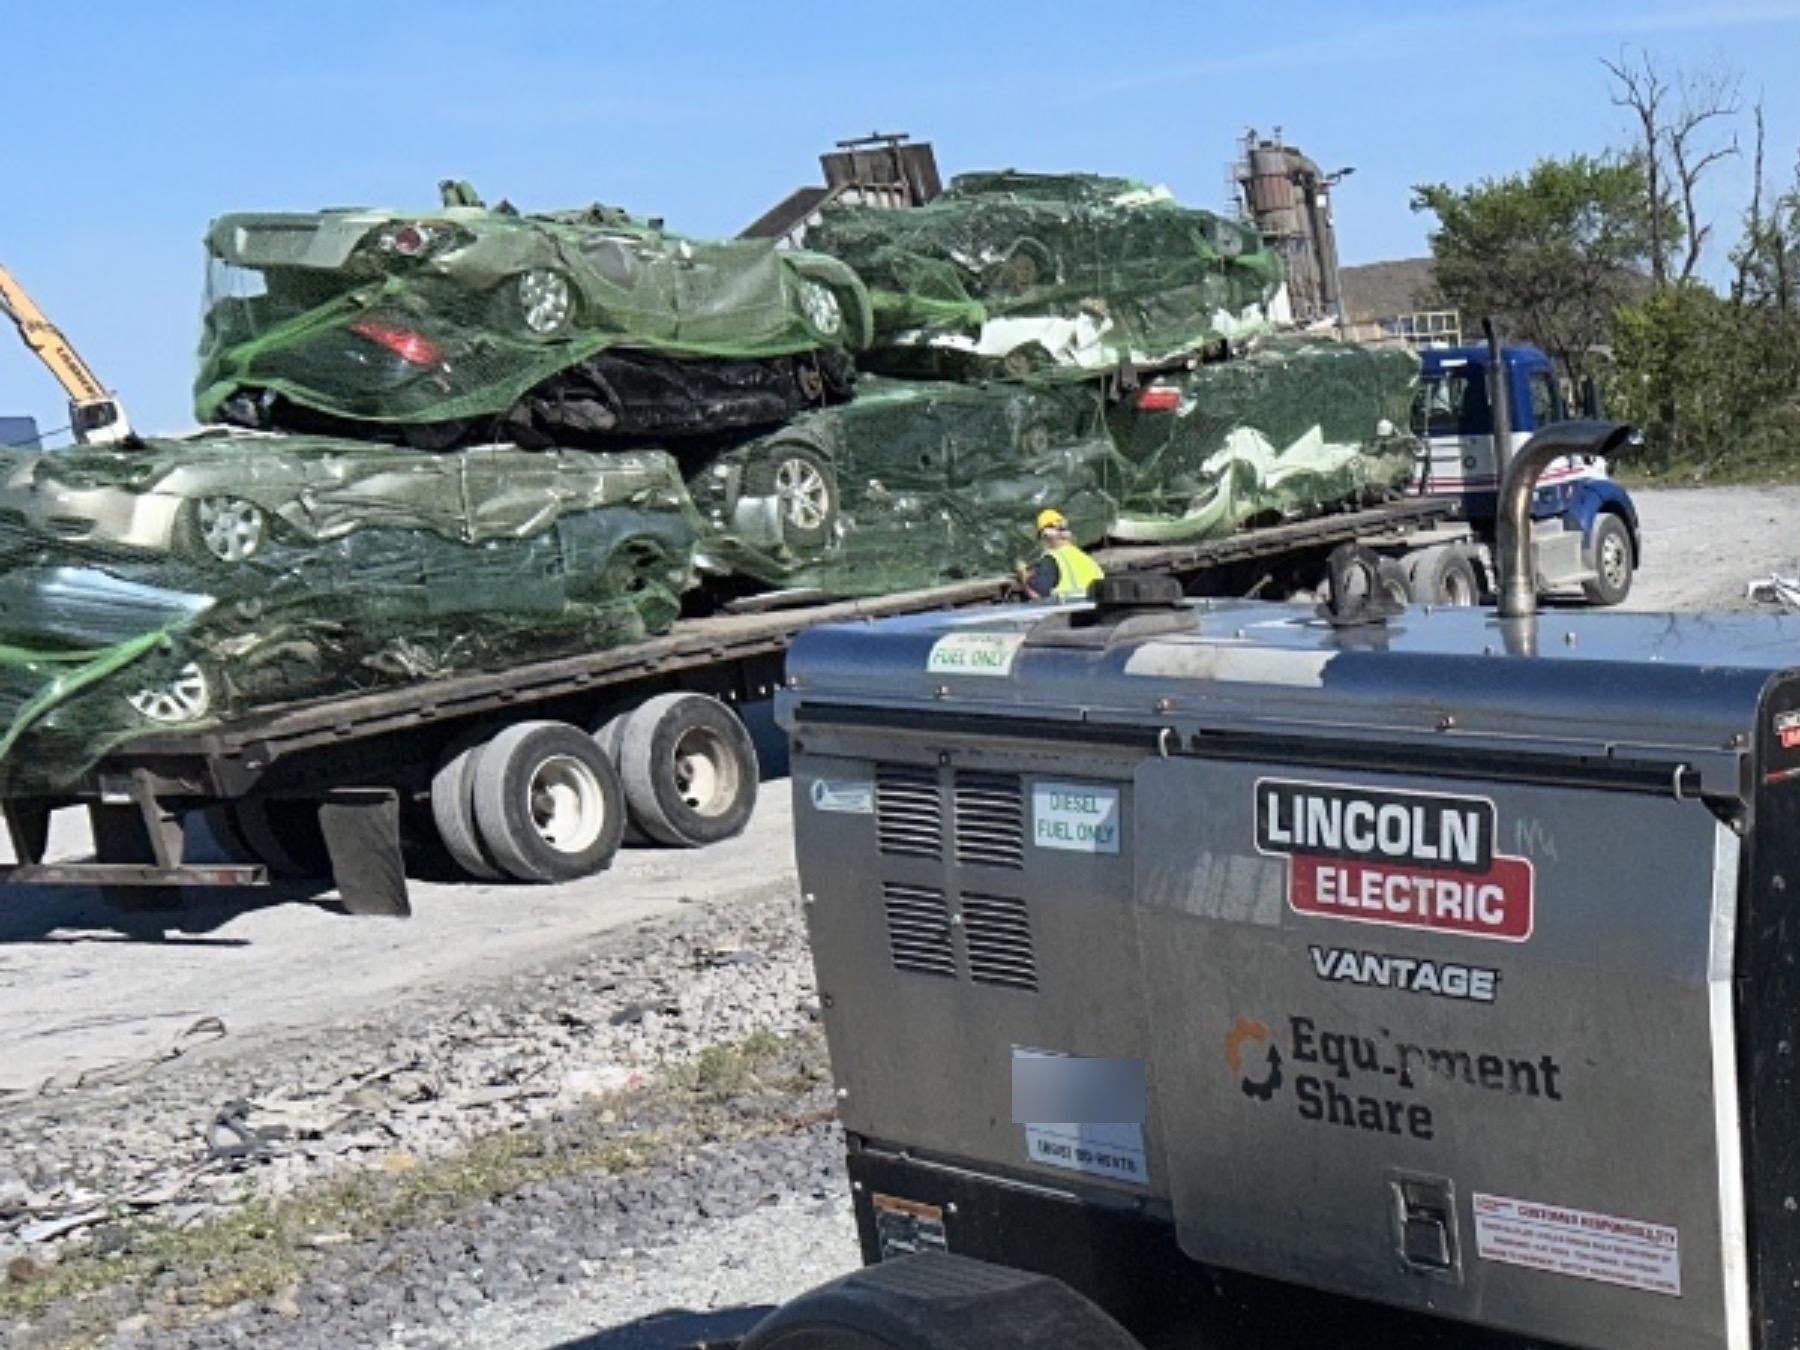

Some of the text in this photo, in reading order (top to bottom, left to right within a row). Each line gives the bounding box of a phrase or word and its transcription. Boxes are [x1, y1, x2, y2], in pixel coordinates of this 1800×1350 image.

[1037, 819, 1115, 844] FUEL ONLY
[1048, 792, 1101, 814] DIESEL
[1266, 791, 1481, 865] LINCOLN
[1315, 865, 1506, 926] ELECTRIC
[1309, 947, 1498, 1002] VANTAGE
[1295, 1074, 1435, 1141] Share
